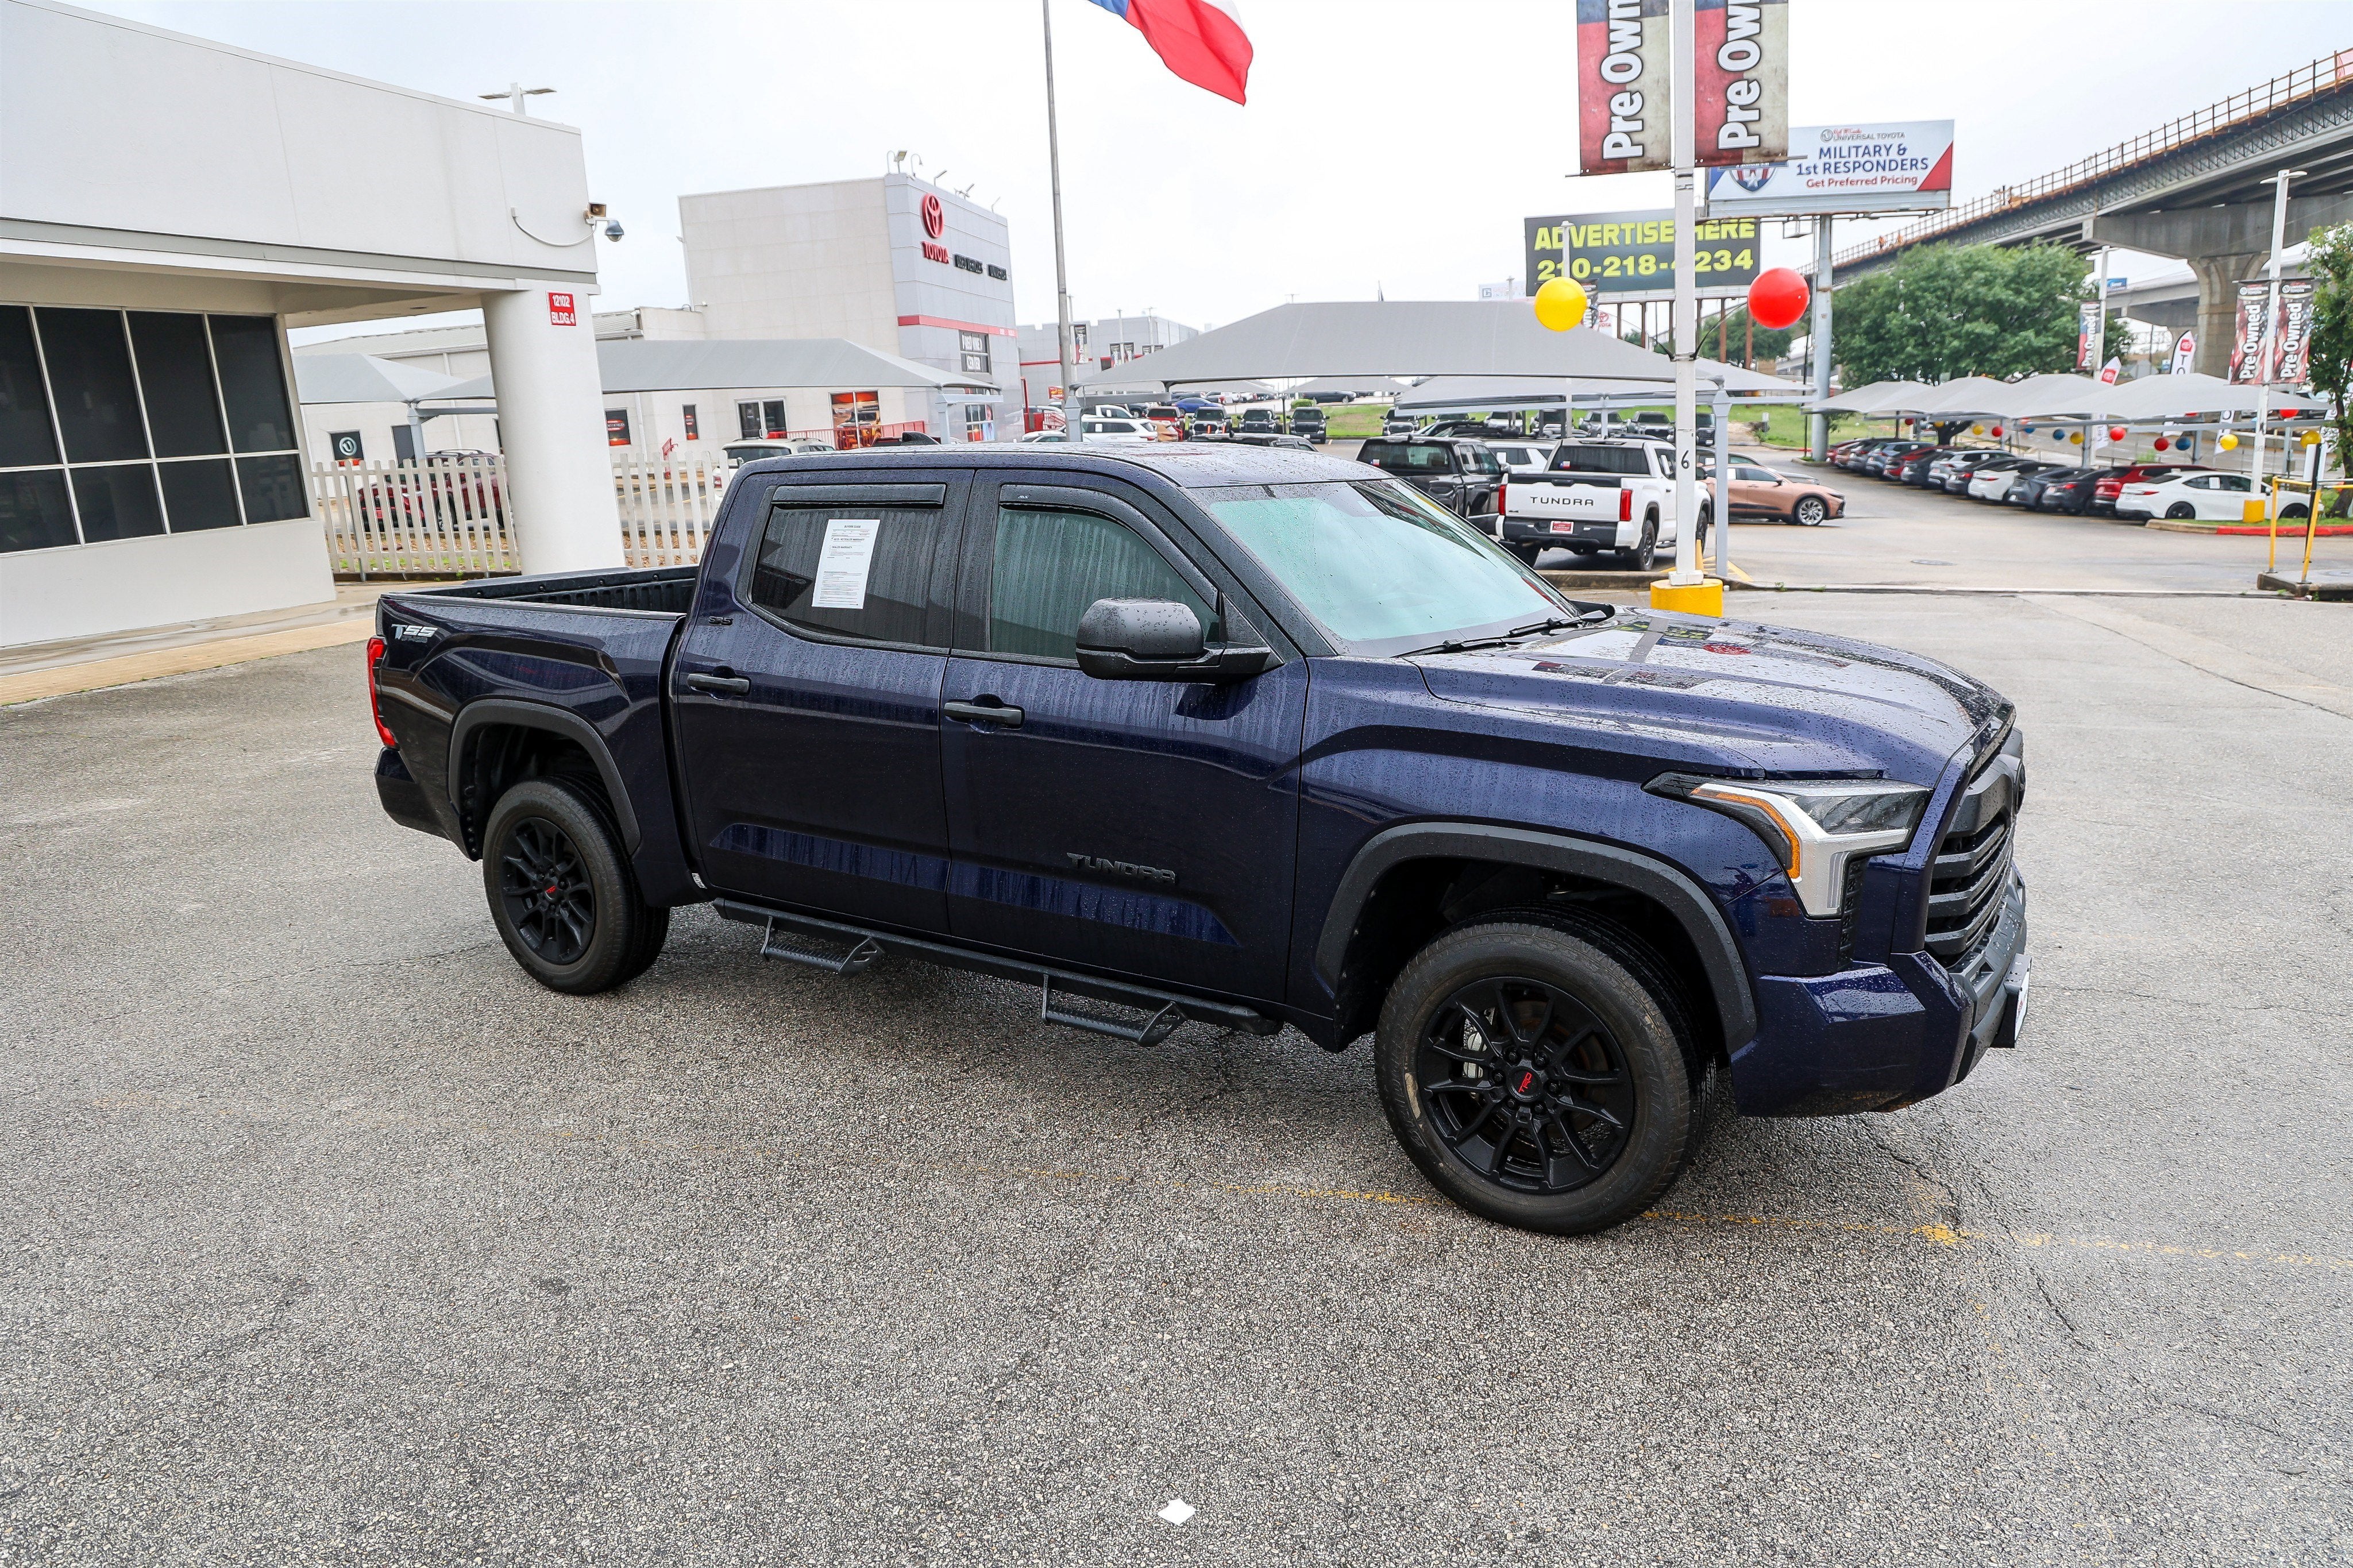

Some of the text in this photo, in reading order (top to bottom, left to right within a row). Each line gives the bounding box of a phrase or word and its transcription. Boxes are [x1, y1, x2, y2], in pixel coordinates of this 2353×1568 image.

[1716, 0, 1762, 72] Ow
[1602, 91, 1644, 159] Pre
[1718, 79, 1761, 150] Pre
[1833, 133, 1875, 141] UNIVERSAL
[1819, 143, 1907, 159] MILITARY &
[1796, 157, 1929, 176] 1st RESPONDERS
[1806, 175, 1919, 188] Get Preferred Pricing
[1534, 219, 1675, 250] ADVERTISE
[921, 240, 949, 264] TOYOTA
[1537, 248, 1754, 281] 20-218-234
[552, 294, 571, 308] 12102
[2242, 304, 2261, 354] Owned
[2282, 302, 2303, 353] Owned
[2239, 354, 2257, 380] Pre
[2280, 353, 2298, 378] Pre
[1681, 450, 1690, 469] 6
[1530, 496, 1594, 506] TUNDRA
[1067, 852, 1176, 884] TUNDRA
[1518, 1072, 1533, 1093] TRD
